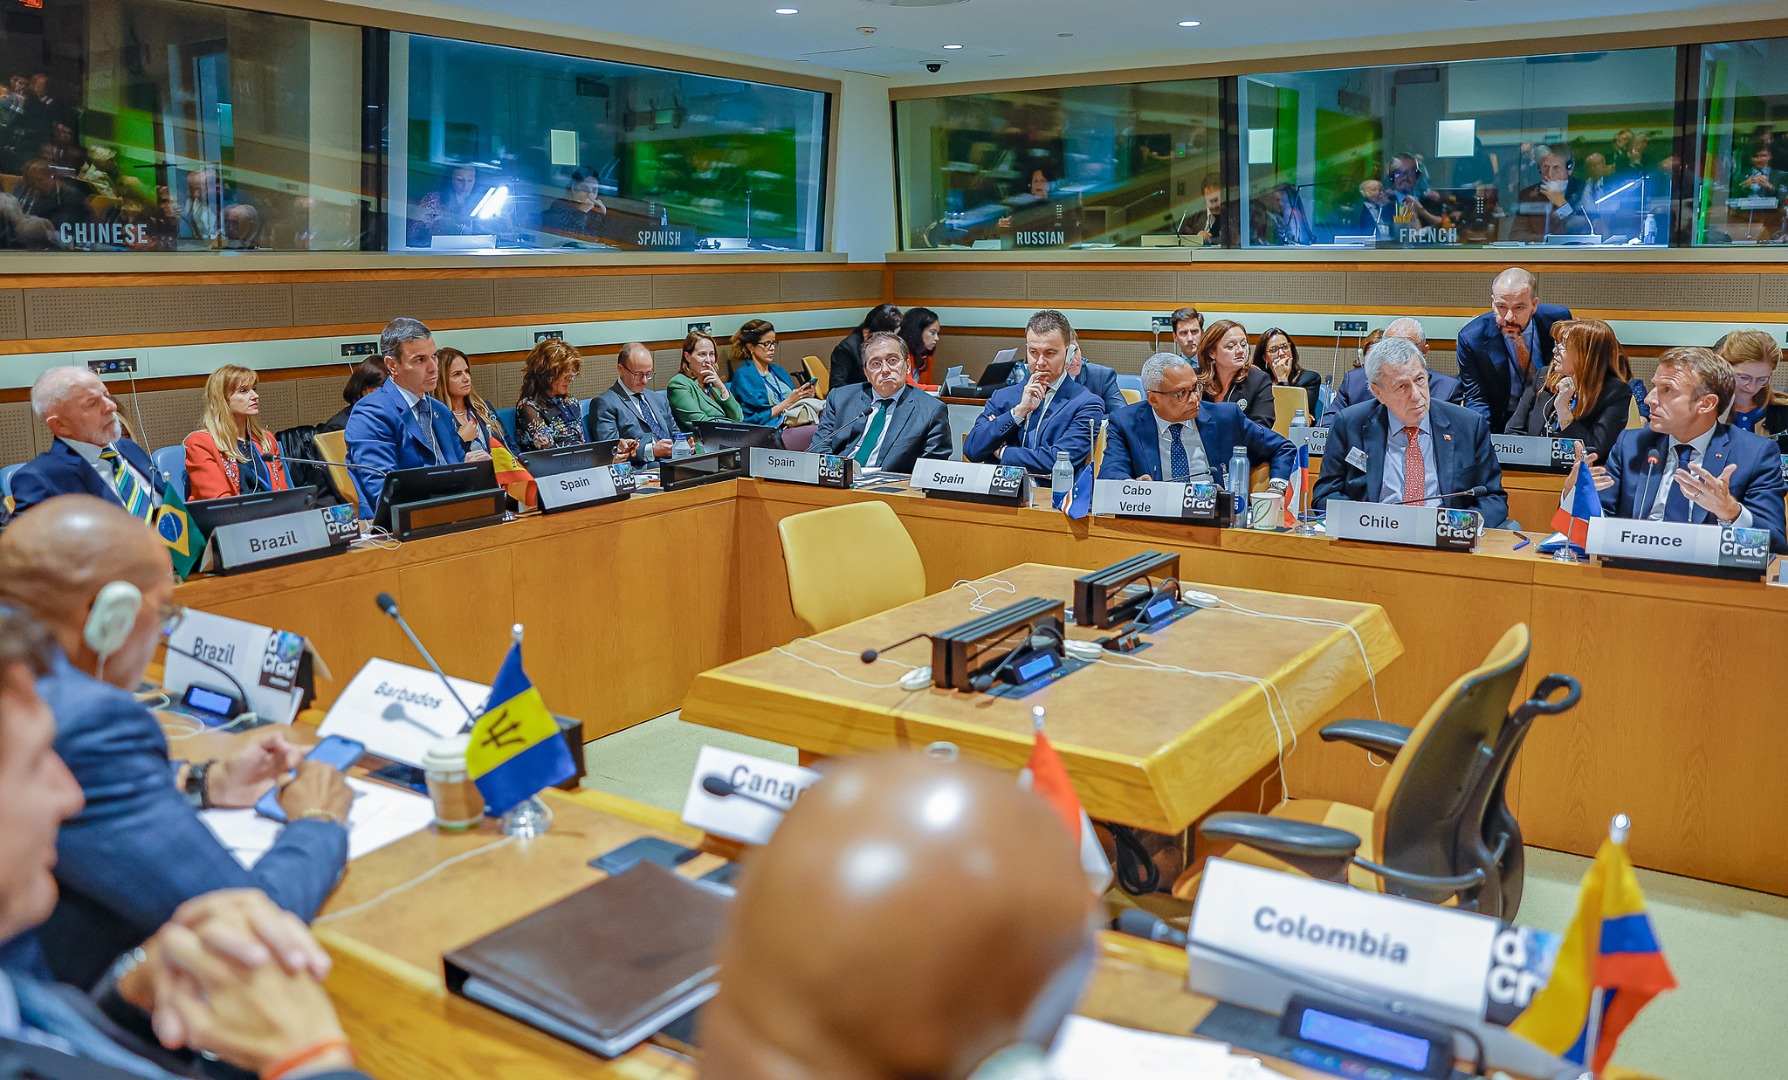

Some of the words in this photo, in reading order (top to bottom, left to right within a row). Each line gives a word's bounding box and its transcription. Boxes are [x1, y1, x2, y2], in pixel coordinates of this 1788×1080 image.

[59, 221, 149, 245] CHINESE
[637, 229, 682, 247] SPANISH
[1016, 230, 1065, 246] RUSSIAN
[1399, 227, 1458, 244] FRENCH
[1312, 430, 1328, 439] Cab
[1310, 443, 1326, 451] Ver
[1493, 443, 1524, 454] Chile
[768, 455, 795, 468] Spain
[559, 477, 590, 492] Spain
[932, 472, 965, 485] Spain
[1122, 485, 1152, 496] Cabo
[1119, 501, 1151, 512] Verde
[1359, 514, 1399, 529] Chile
[249, 530, 298, 553] Brazil
[1620, 530, 1683, 547] France
[193, 636, 236, 666] Brazil
[373, 681, 443, 708] Barbados
[1253, 905, 1411, 965] Colombia
[1487, 965, 1541, 1008] cr
